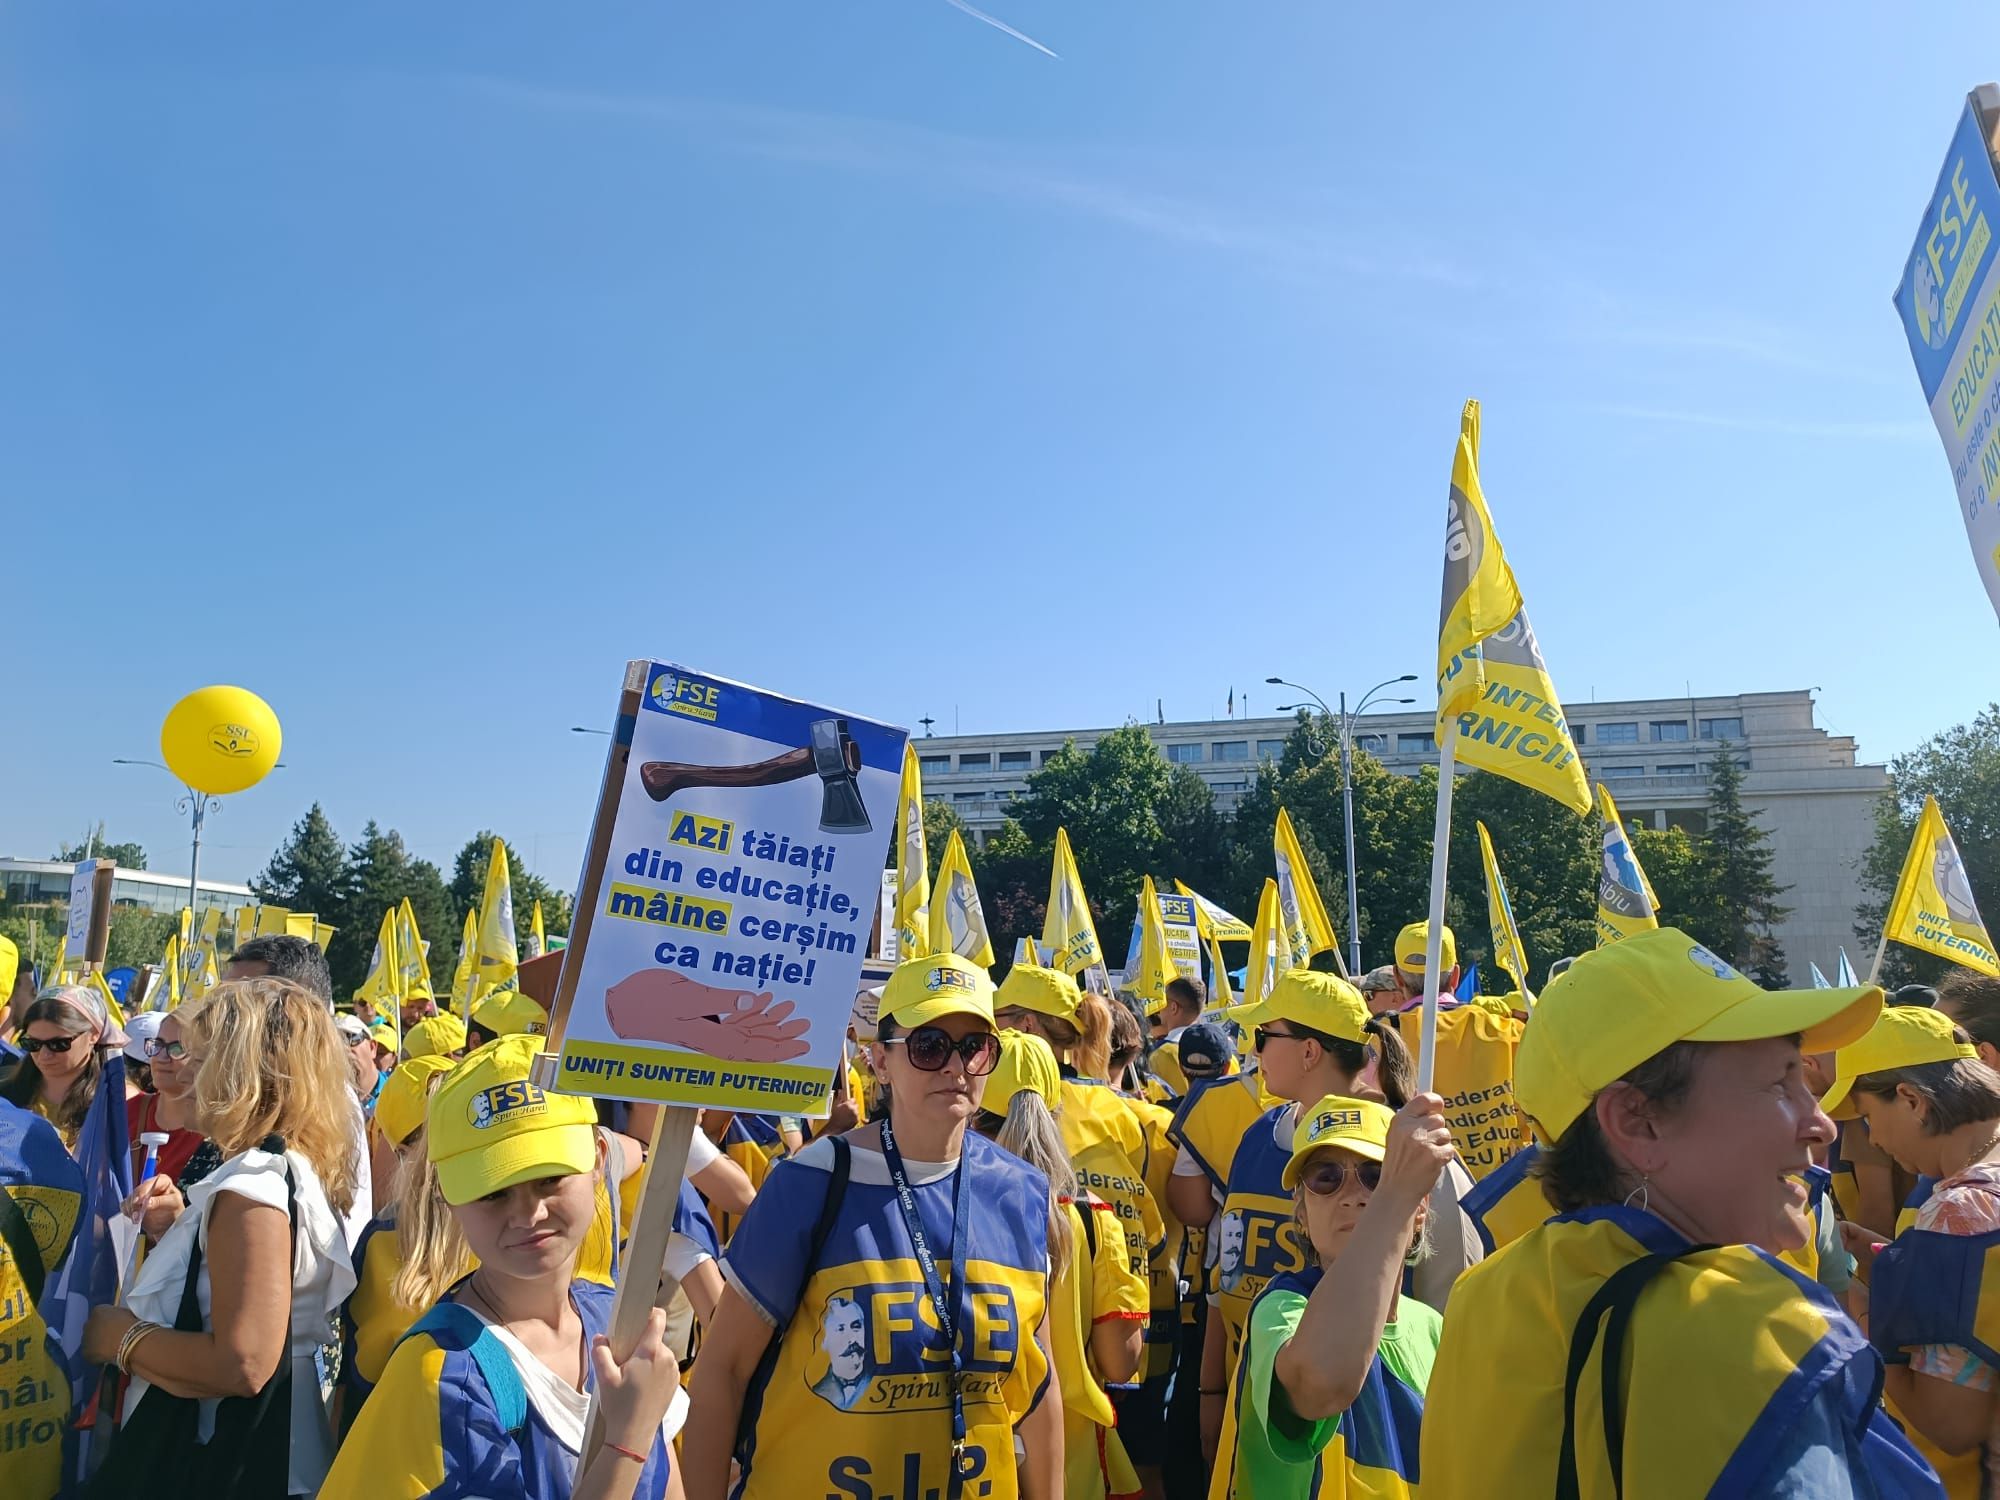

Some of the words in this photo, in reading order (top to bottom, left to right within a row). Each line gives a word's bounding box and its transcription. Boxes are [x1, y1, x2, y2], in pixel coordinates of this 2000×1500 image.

[1926, 156, 1977, 289] FSE
[1966, 421, 1984, 463] este
[676, 680, 720, 707] FSE
[1457, 712, 1575, 770] RNICI!
[670, 815, 731, 851] Azi
[742, 830, 836, 879] tăiați
[624, 847, 683, 883] din
[696, 866, 860, 922] educație,
[610, 892, 727, 931] mâine
[739, 916, 857, 955] cerșim
[1166, 900, 1189, 914] FSE
[654, 942, 700, 969] ca
[712, 952, 816, 989] nație!
[1914, 924, 1998, 968] PUTERNIC
[942, 969, 976, 990] FSE
[489, 1082, 543, 1112] FSE
[565, 1056, 625, 1081] UNIȚI
[630, 1063, 715, 1086] SUNTEM
[719, 1072, 825, 1097] PUTERNICI!
[1319, 1112, 1360, 1129] FSE
[895, 1170, 913, 1210] syngenta
[1075, 1168, 1145, 1197] derația
[915, 1231, 933, 1273] syngenta
[1244, 1217, 1305, 1273] FS
[1242, 1277, 1265, 1298] Sp
[871, 1291, 1012, 1365] FSE
[869, 1375, 941, 1408] Spiru
